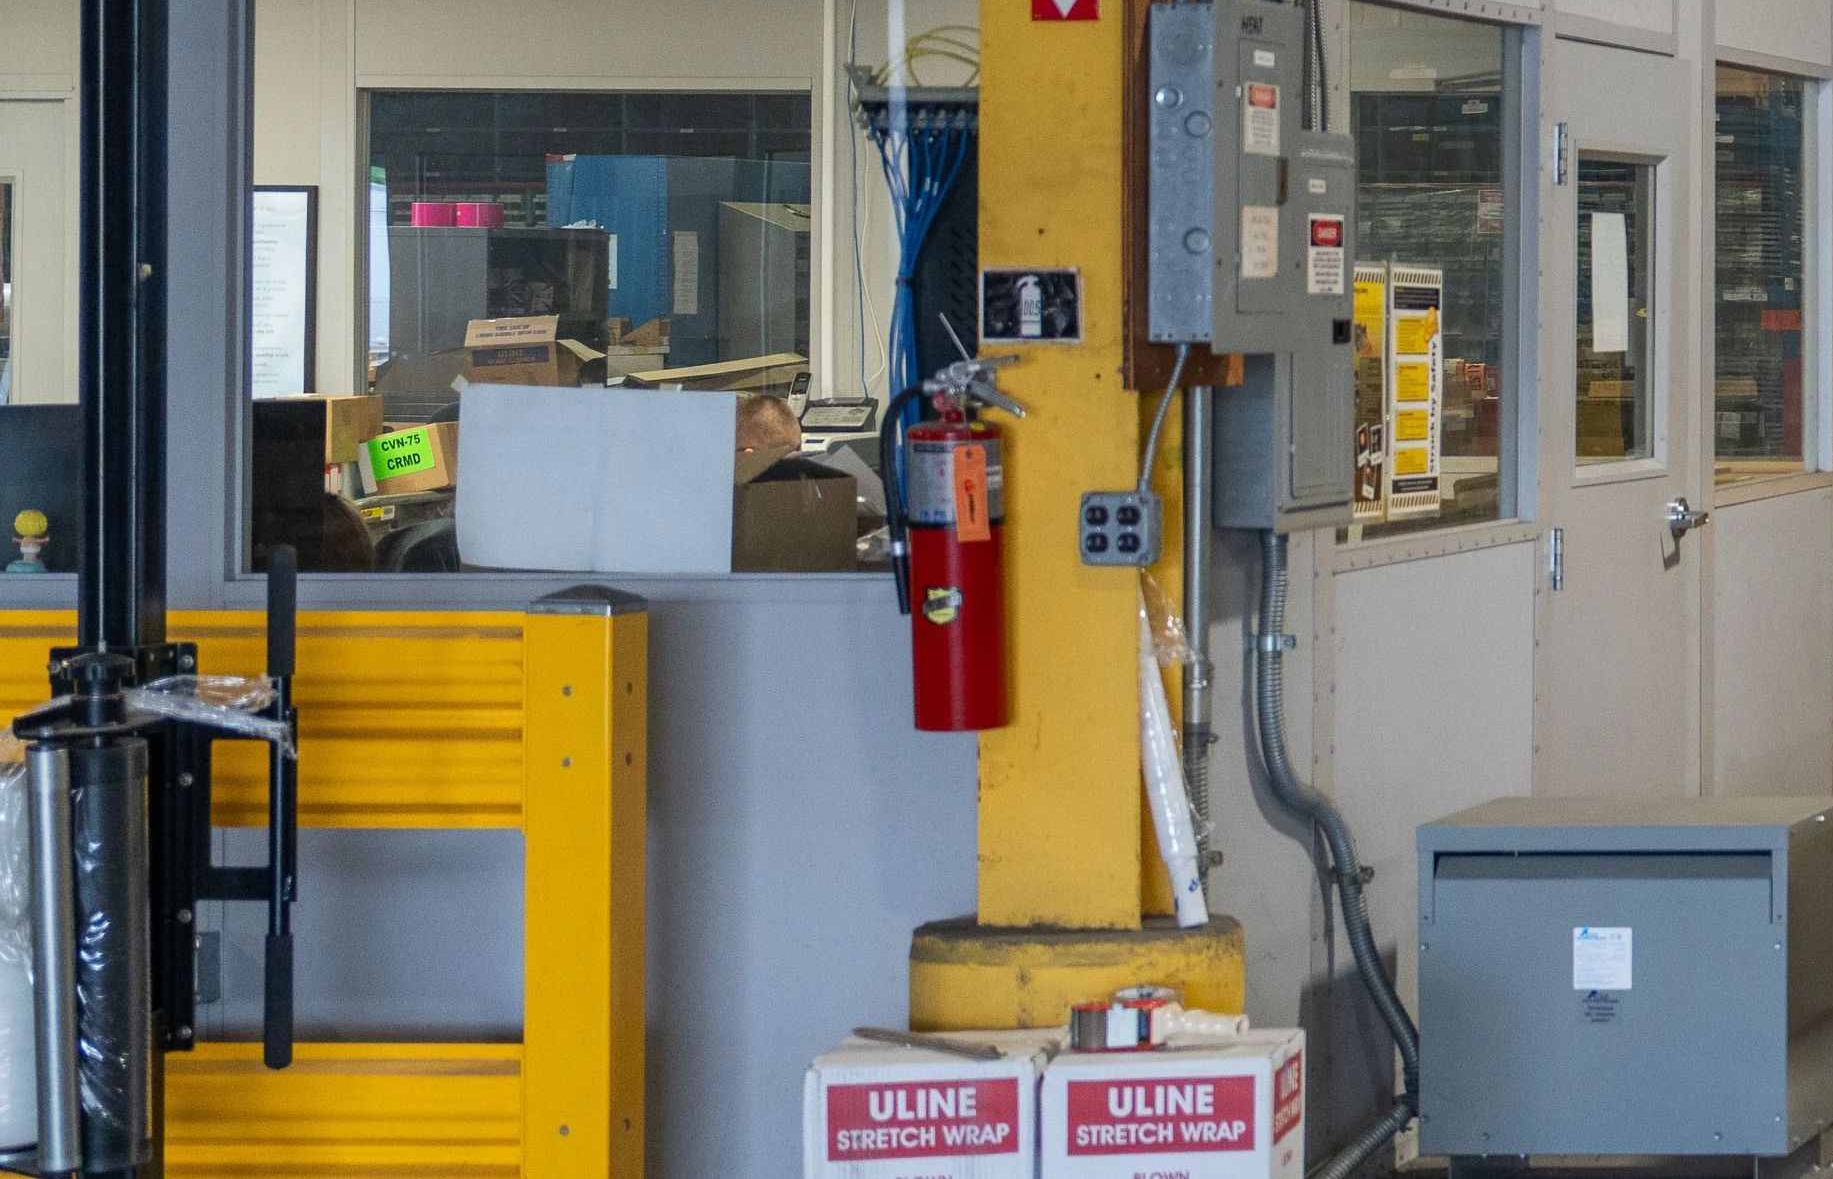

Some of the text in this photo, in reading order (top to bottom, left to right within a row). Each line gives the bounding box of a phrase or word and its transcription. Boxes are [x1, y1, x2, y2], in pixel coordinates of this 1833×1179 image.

[1429, 341, 1437, 392] Safety
[381, 434, 421, 452] CVN-75
[1429, 422, 1437, 473] Struck
[386, 453, 421, 470] CRMD
[868, 1087, 977, 1122] ULINE
[1107, 1084, 1215, 1118] ULINE
[836, 1124, 1010, 1150] STRETCH WRAP
[1075, 1121, 1247, 1147] STRETCH WRAP
